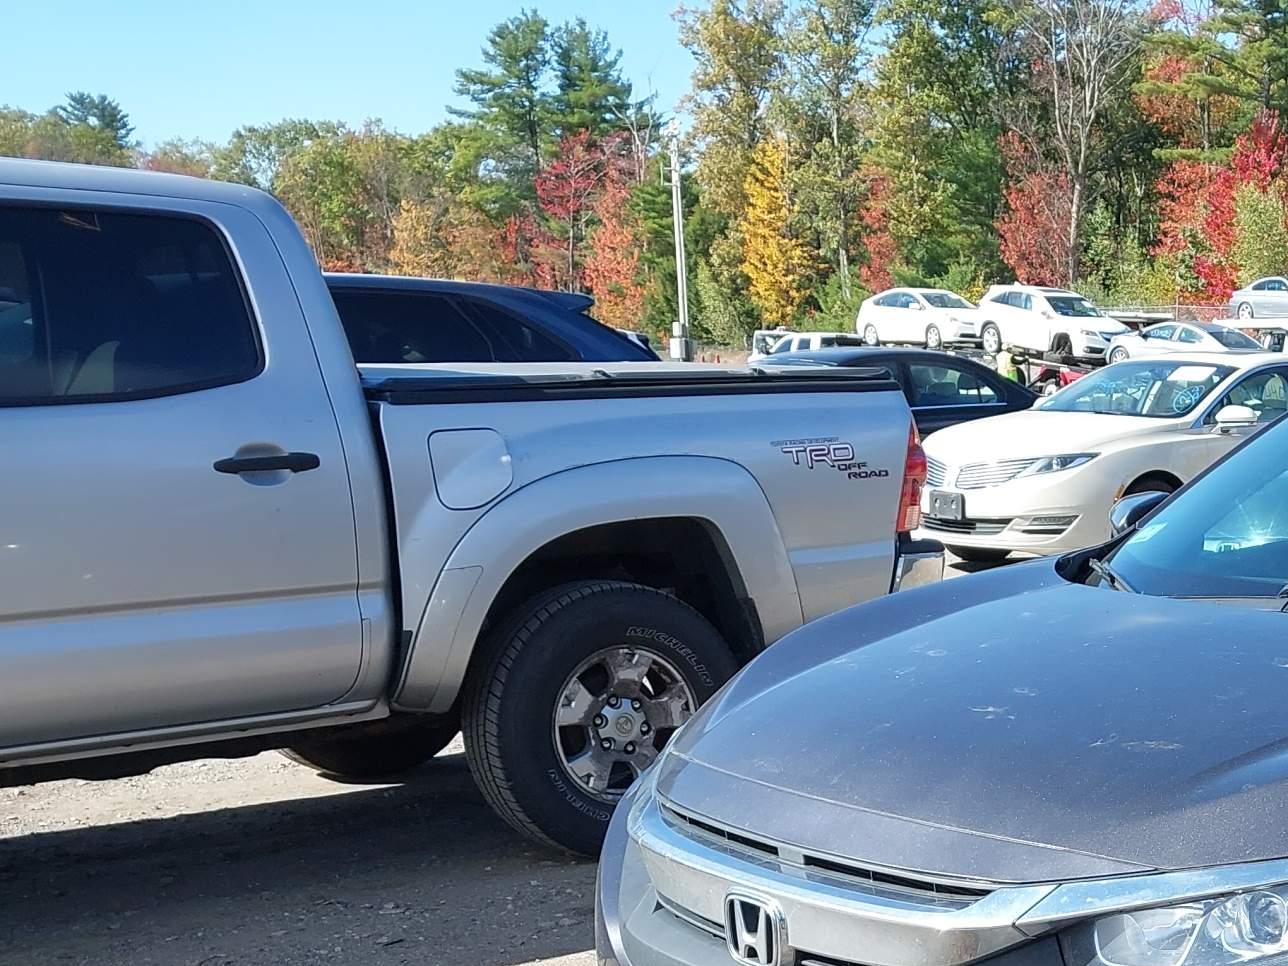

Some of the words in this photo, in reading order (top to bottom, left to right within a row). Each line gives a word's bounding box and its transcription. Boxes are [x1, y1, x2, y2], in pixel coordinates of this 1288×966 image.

[781, 442, 855, 470] TRD
[837, 461, 868, 472] OFF
[847, 469, 889, 480] ROAD
[626, 626, 714, 686] MICHELIN
